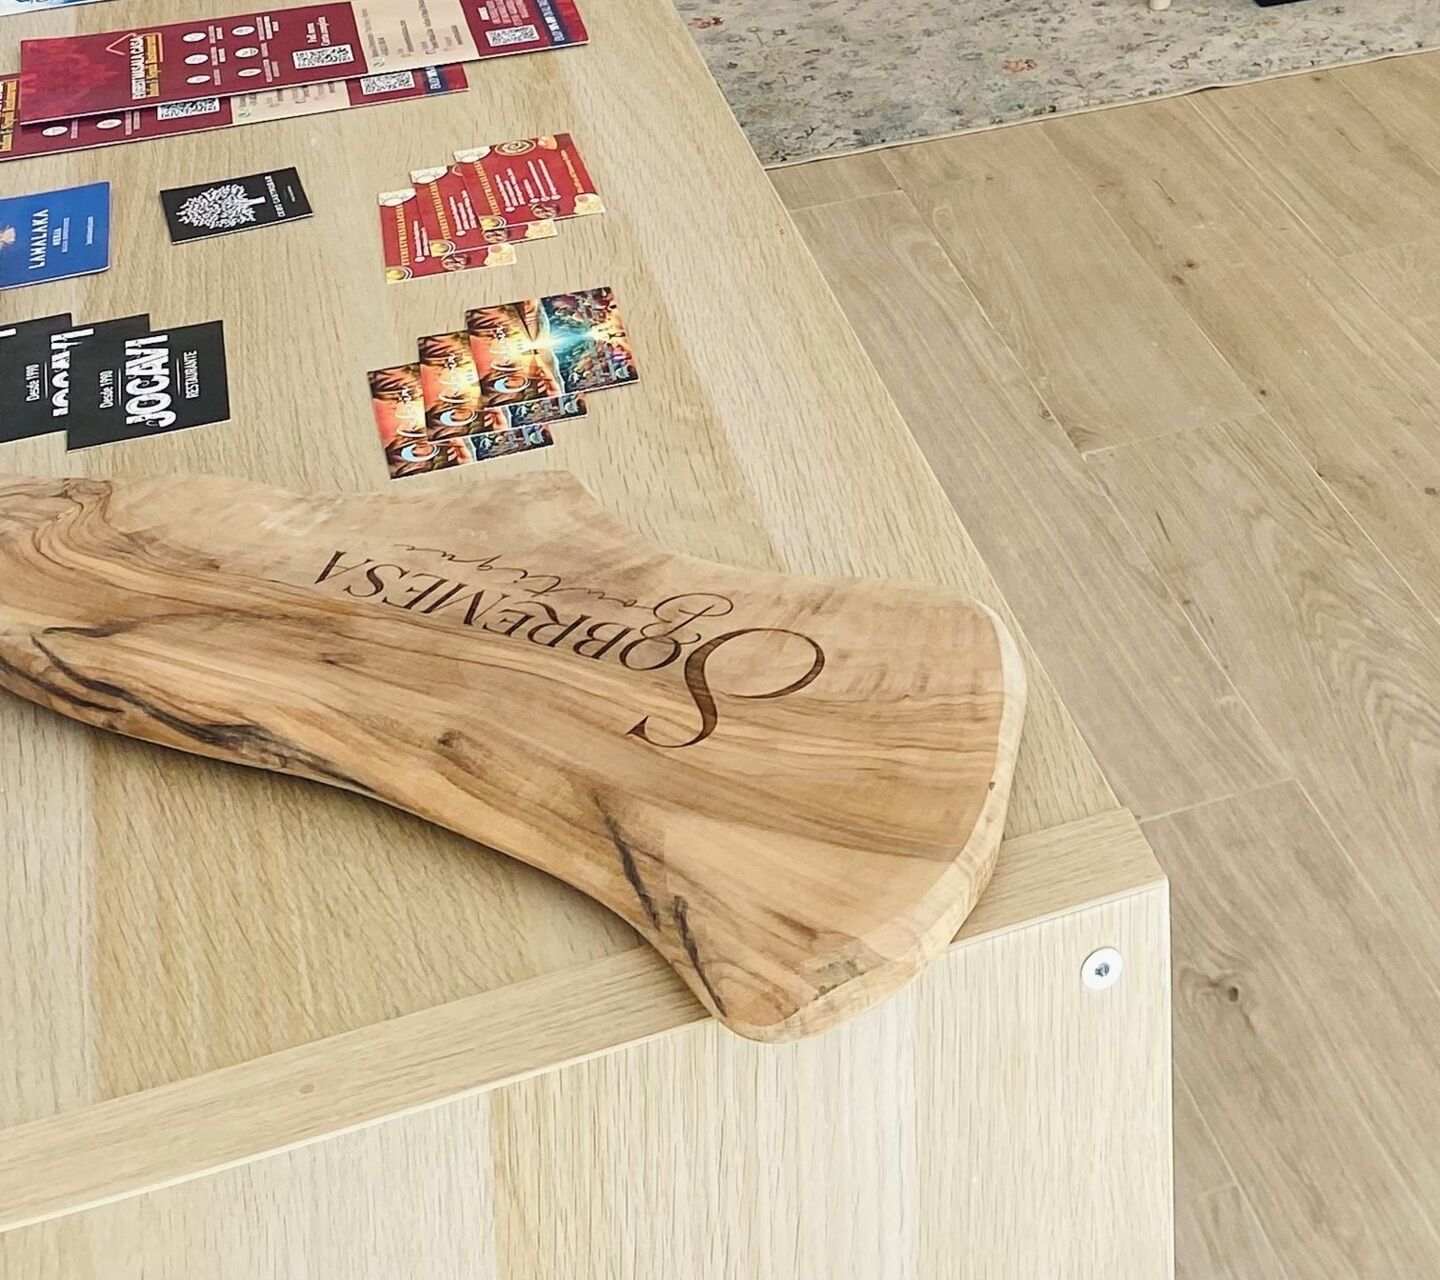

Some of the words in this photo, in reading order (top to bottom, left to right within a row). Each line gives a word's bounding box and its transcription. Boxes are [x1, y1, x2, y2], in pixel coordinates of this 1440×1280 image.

[28, 209, 49, 269] LAMALAKA
[25, 364, 40, 381] 1990
[25, 381, 40, 402] Desde
[99, 370, 114, 387] 1990
[124, 334, 177, 428] JOCAVI
[183, 350, 200, 399] RESTAURANTE
[99, 386, 114, 409] Desde
[394, 544, 734, 646] Boutique
[313, 550, 826, 748] SOBREMESA
